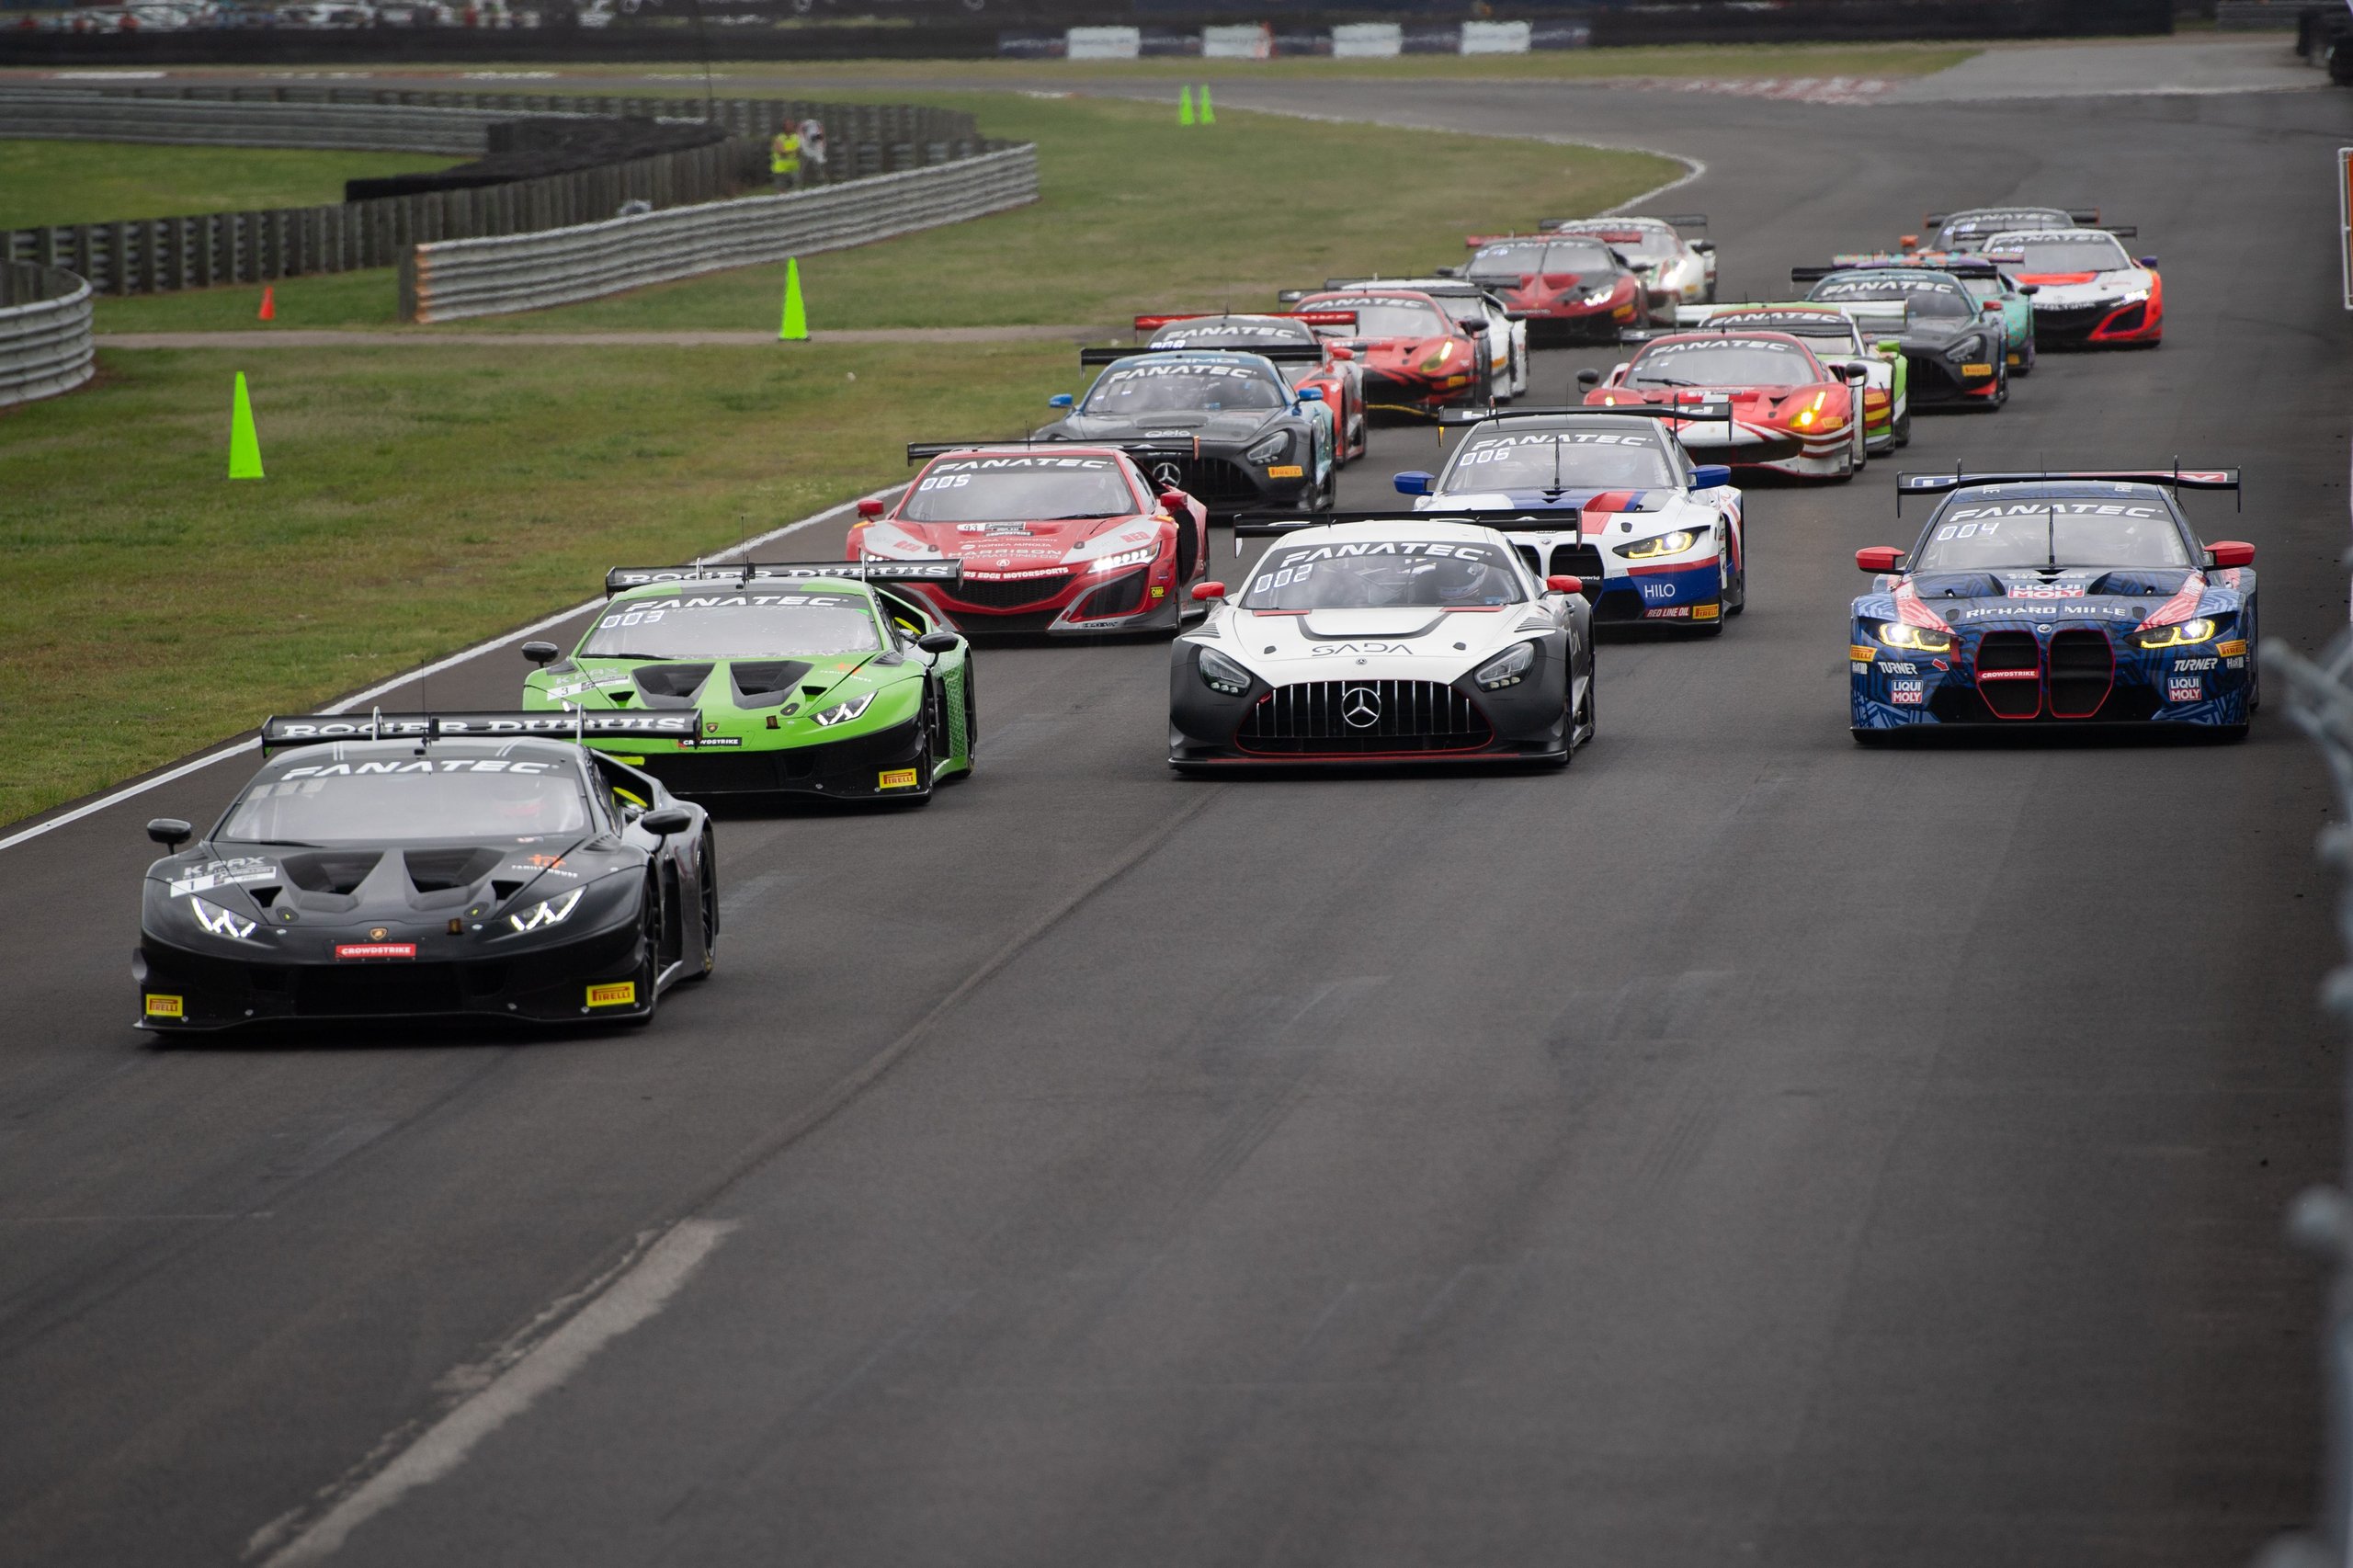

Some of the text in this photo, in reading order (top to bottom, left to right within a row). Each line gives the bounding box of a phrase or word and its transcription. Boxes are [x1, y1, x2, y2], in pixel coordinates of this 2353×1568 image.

[1820, 280, 1954, 297] FANATEC
[1300, 297, 1424, 312] FANATEC
[1707, 312, 1840, 328] FANATEC
[1163, 326, 1297, 342] FANATEC
[1649, 339, 1788, 358] FANATEC
[1108, 365, 1254, 384] FANATEC
[1471, 434, 1648, 451] FANATEC
[1459, 448, 1512, 466] 006
[932, 458, 1108, 475] FANATEC
[919, 474, 972, 491] 005
[1949, 504, 2156, 523] FANATEC
[1936, 522, 2000, 541] 004
[948, 549, 1062, 558] HARRISON
[1279, 542, 1485, 569] FANATEC
[622, 571, 772, 584] ROGER
[788, 565, 949, 577] DUBUIS
[978, 571, 1001, 580] EDGE
[1003, 566, 1069, 580] MOTORSPORTS
[1254, 563, 1313, 594] 002
[1151, 587, 1165, 597] OMP
[1643, 583, 1676, 598] HILO
[2014, 589, 2080, 598] MOLY
[625, 596, 842, 613] FANATEC
[1695, 605, 1719, 618] PIRELLI
[599, 609, 665, 630] 003
[1646, 607, 1690, 618] RED LINE OIL
[1311, 642, 1415, 657] SADA
[1877, 661, 1918, 675] TURNER
[2174, 657, 2219, 672] TURNER
[555, 676, 570, 685] K
[1982, 670, 2036, 678] CROWDSTRIKE
[1893, 681, 1922, 692] LIQUI
[2170, 677, 2200, 689] LIQUI
[561, 687, 569, 696] 3
[1893, 691, 1922, 702] MOLY
[2171, 688, 2200, 700] MOLY
[280, 717, 686, 736] ROGER DUBUIS
[683, 738, 739, 746] CRWDSTRIKE
[280, 759, 550, 781] FANATEC
[882, 771, 914, 785] PIRELLI
[183, 864, 203, 876] K
[207, 856, 265, 872] PAX
[340, 946, 412, 955] CROWDSTRIKE
[592, 985, 631, 1002] PIRELLI
[149, 998, 179, 1012] PIRELLI
